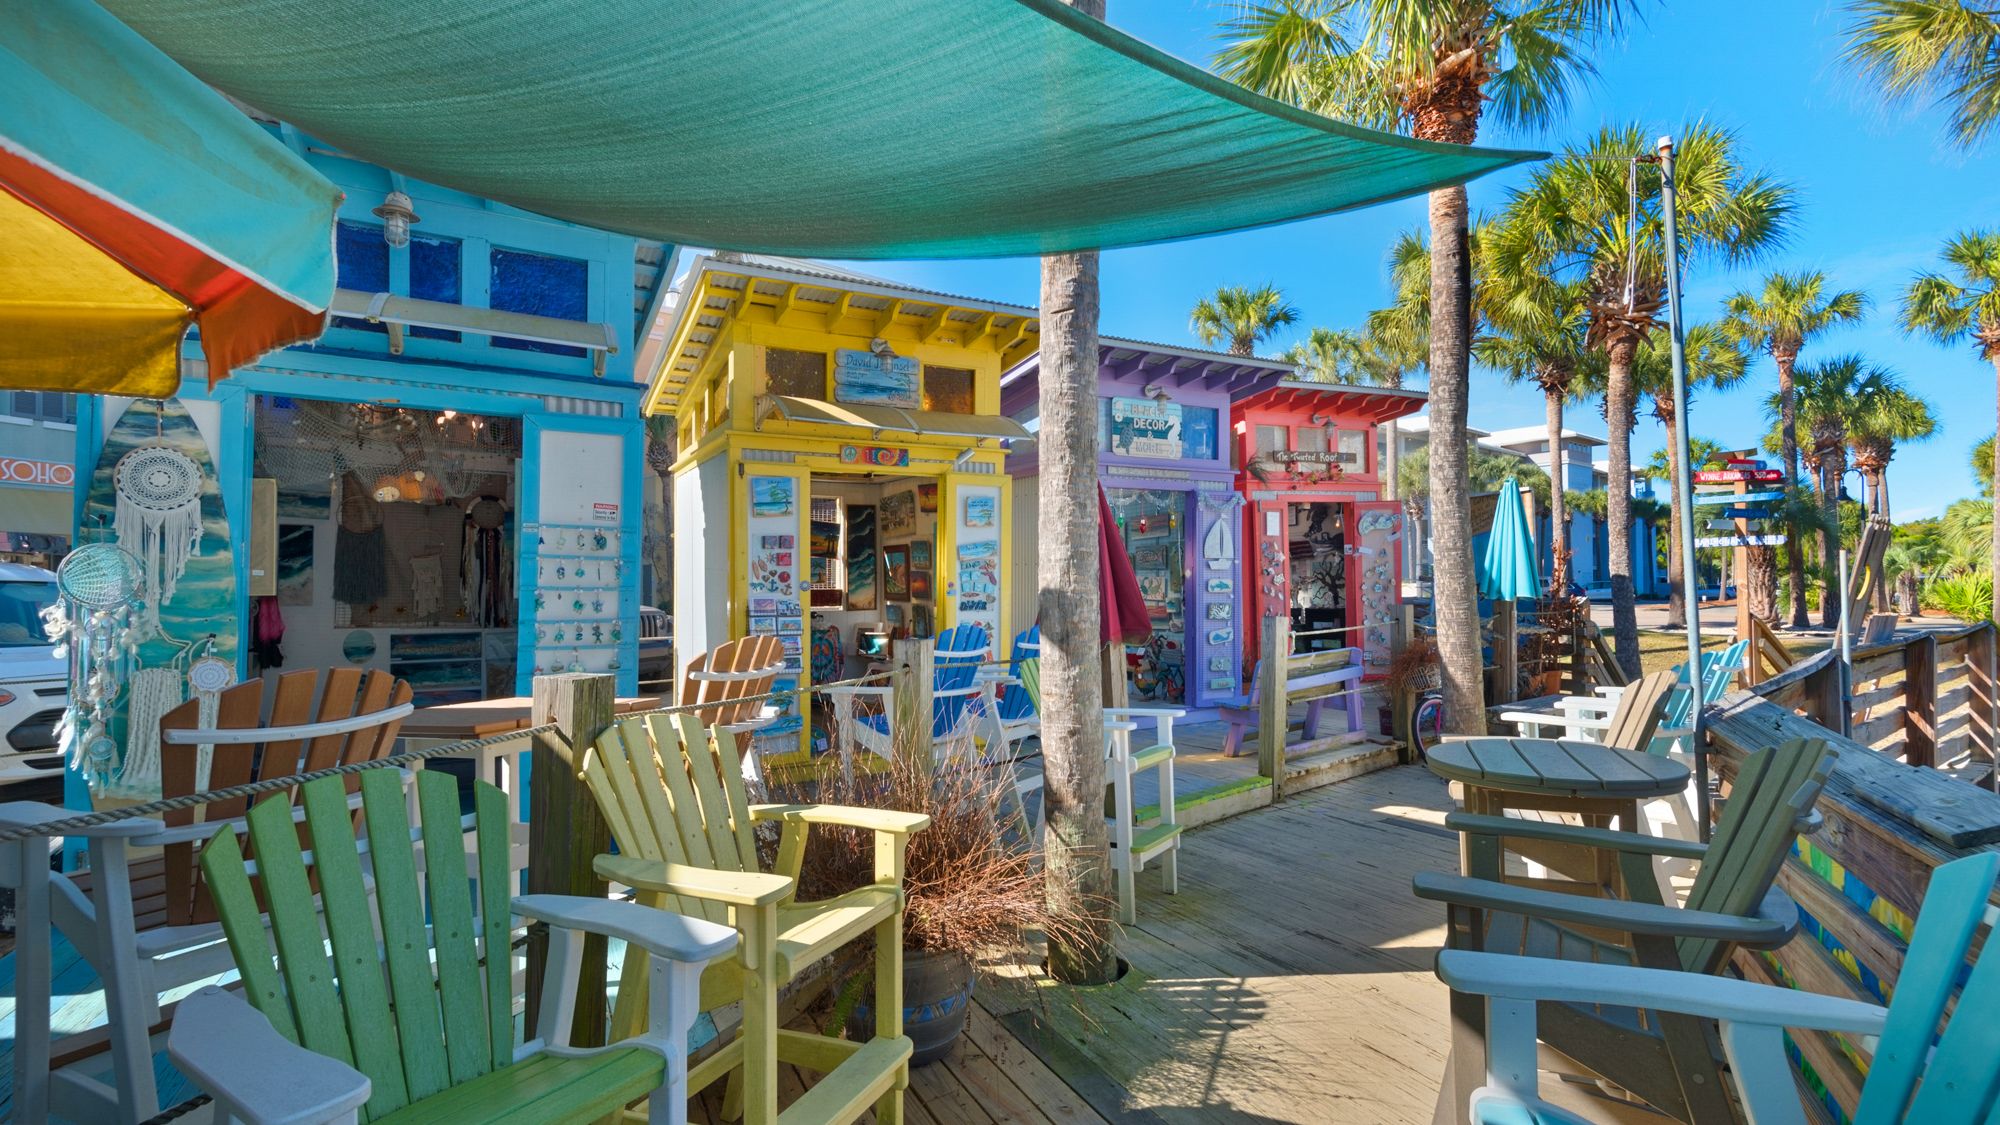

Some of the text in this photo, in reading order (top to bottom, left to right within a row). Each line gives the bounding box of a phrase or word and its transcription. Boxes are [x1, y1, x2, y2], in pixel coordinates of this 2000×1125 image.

[846, 354, 872, 368] David
[1133, 418, 1166, 431] DECOR
[1276, 451, 1288, 461] The
[1, 459, 75, 485] SOHO
